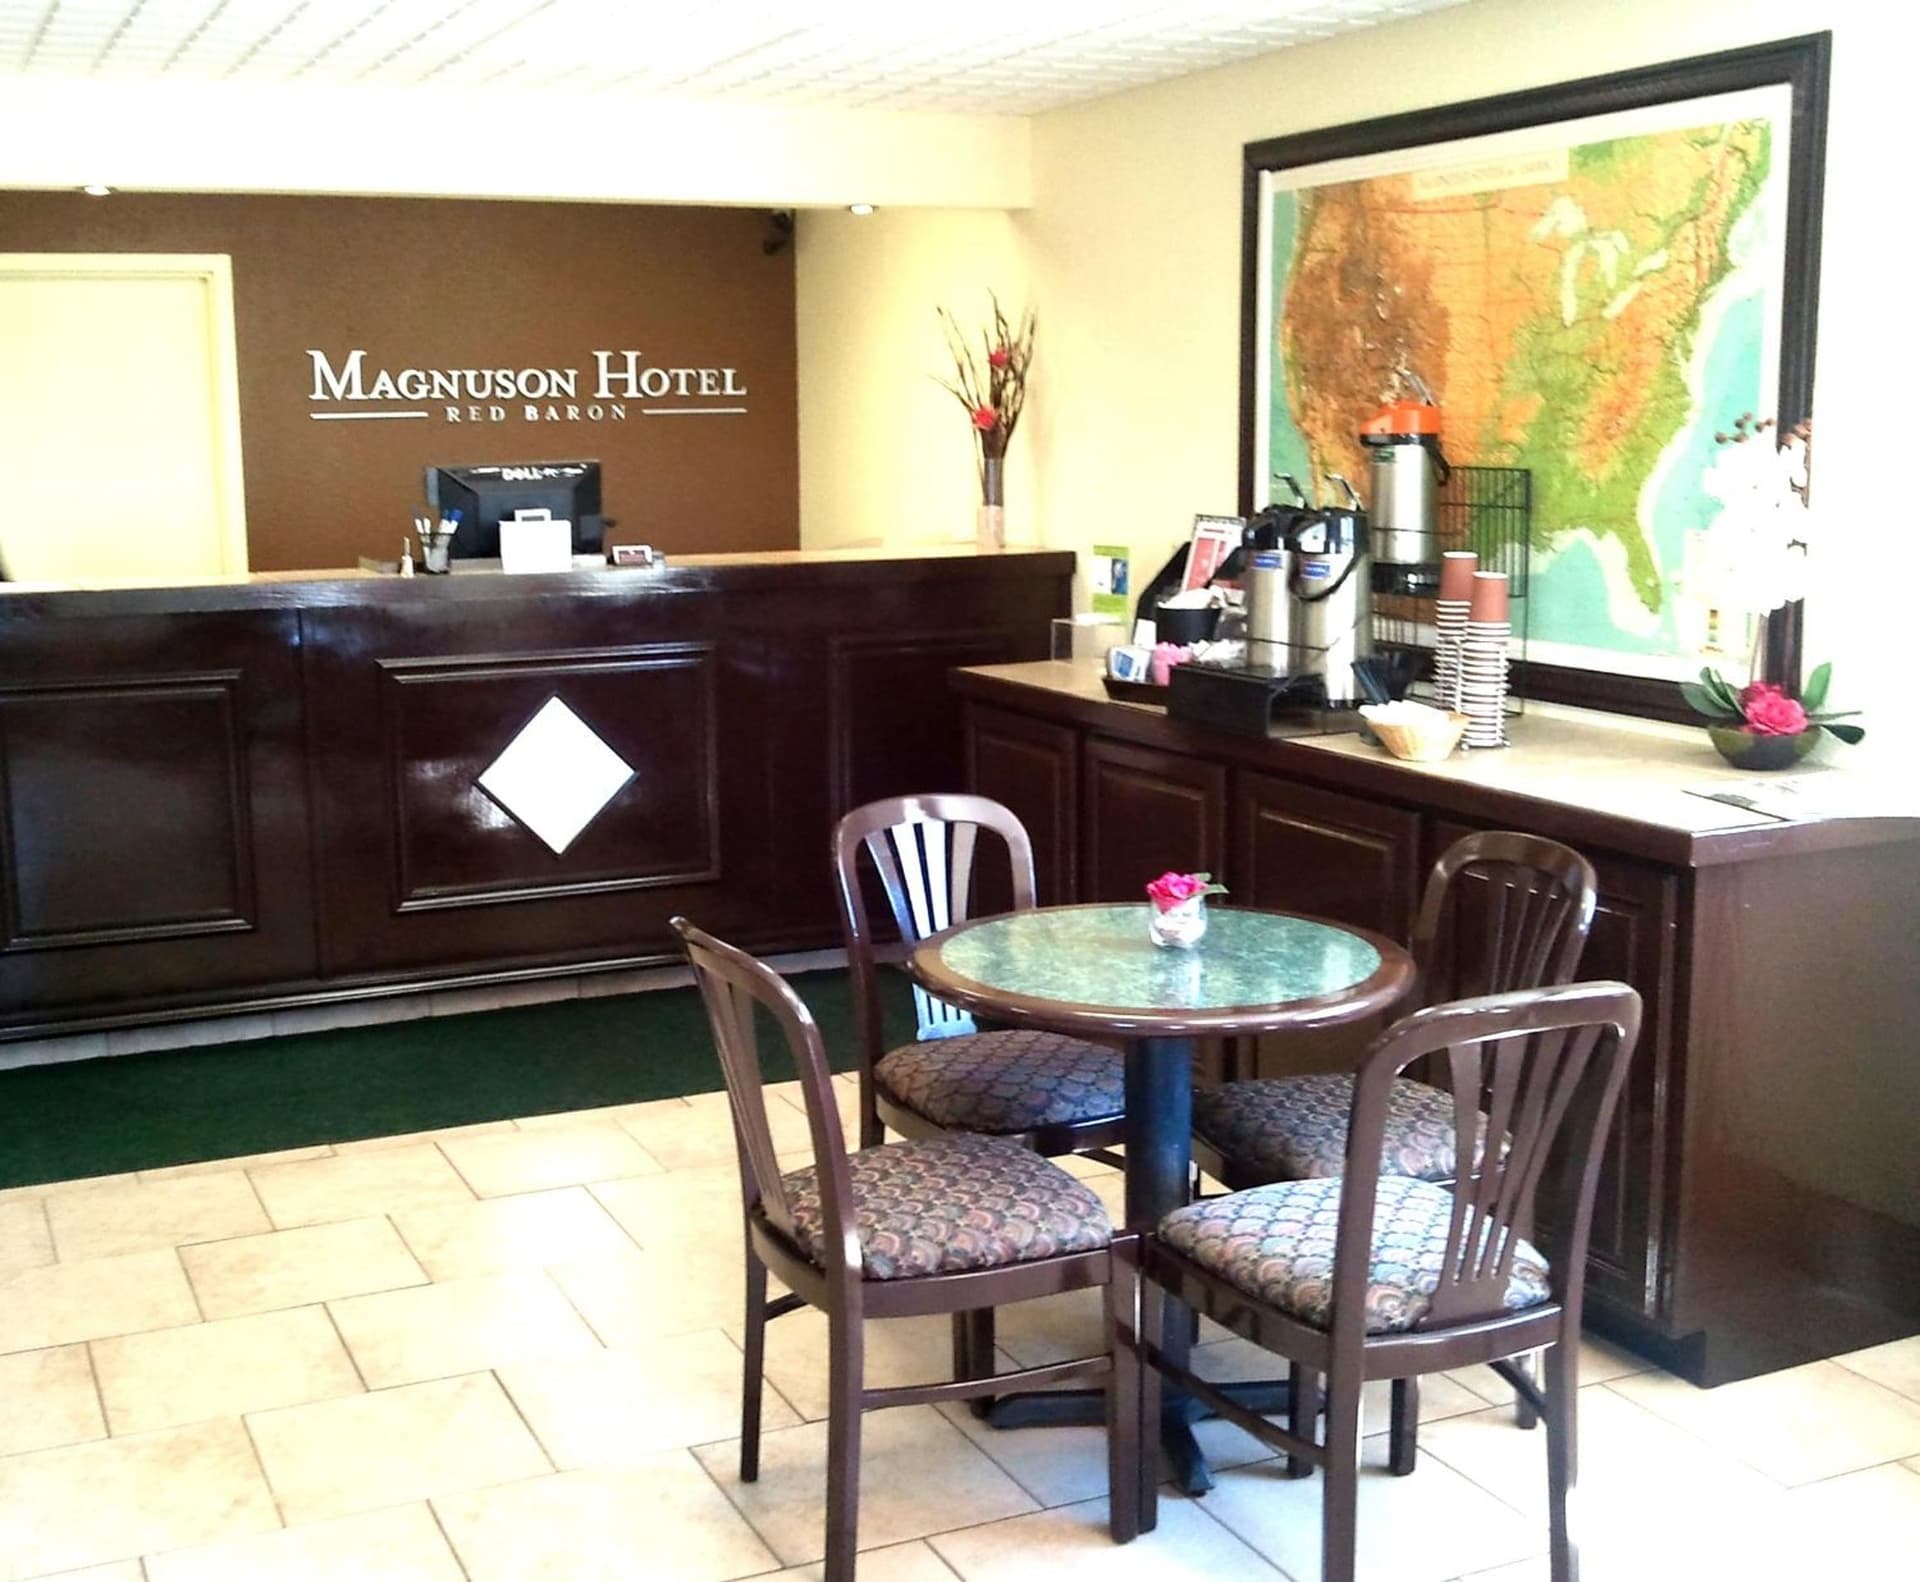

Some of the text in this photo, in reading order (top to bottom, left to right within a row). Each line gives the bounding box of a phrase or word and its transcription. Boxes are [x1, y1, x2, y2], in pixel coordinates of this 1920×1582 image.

[305, 349, 748, 400] MAGNUSON HOTEL
[446, 404, 626, 422] RED BARON
